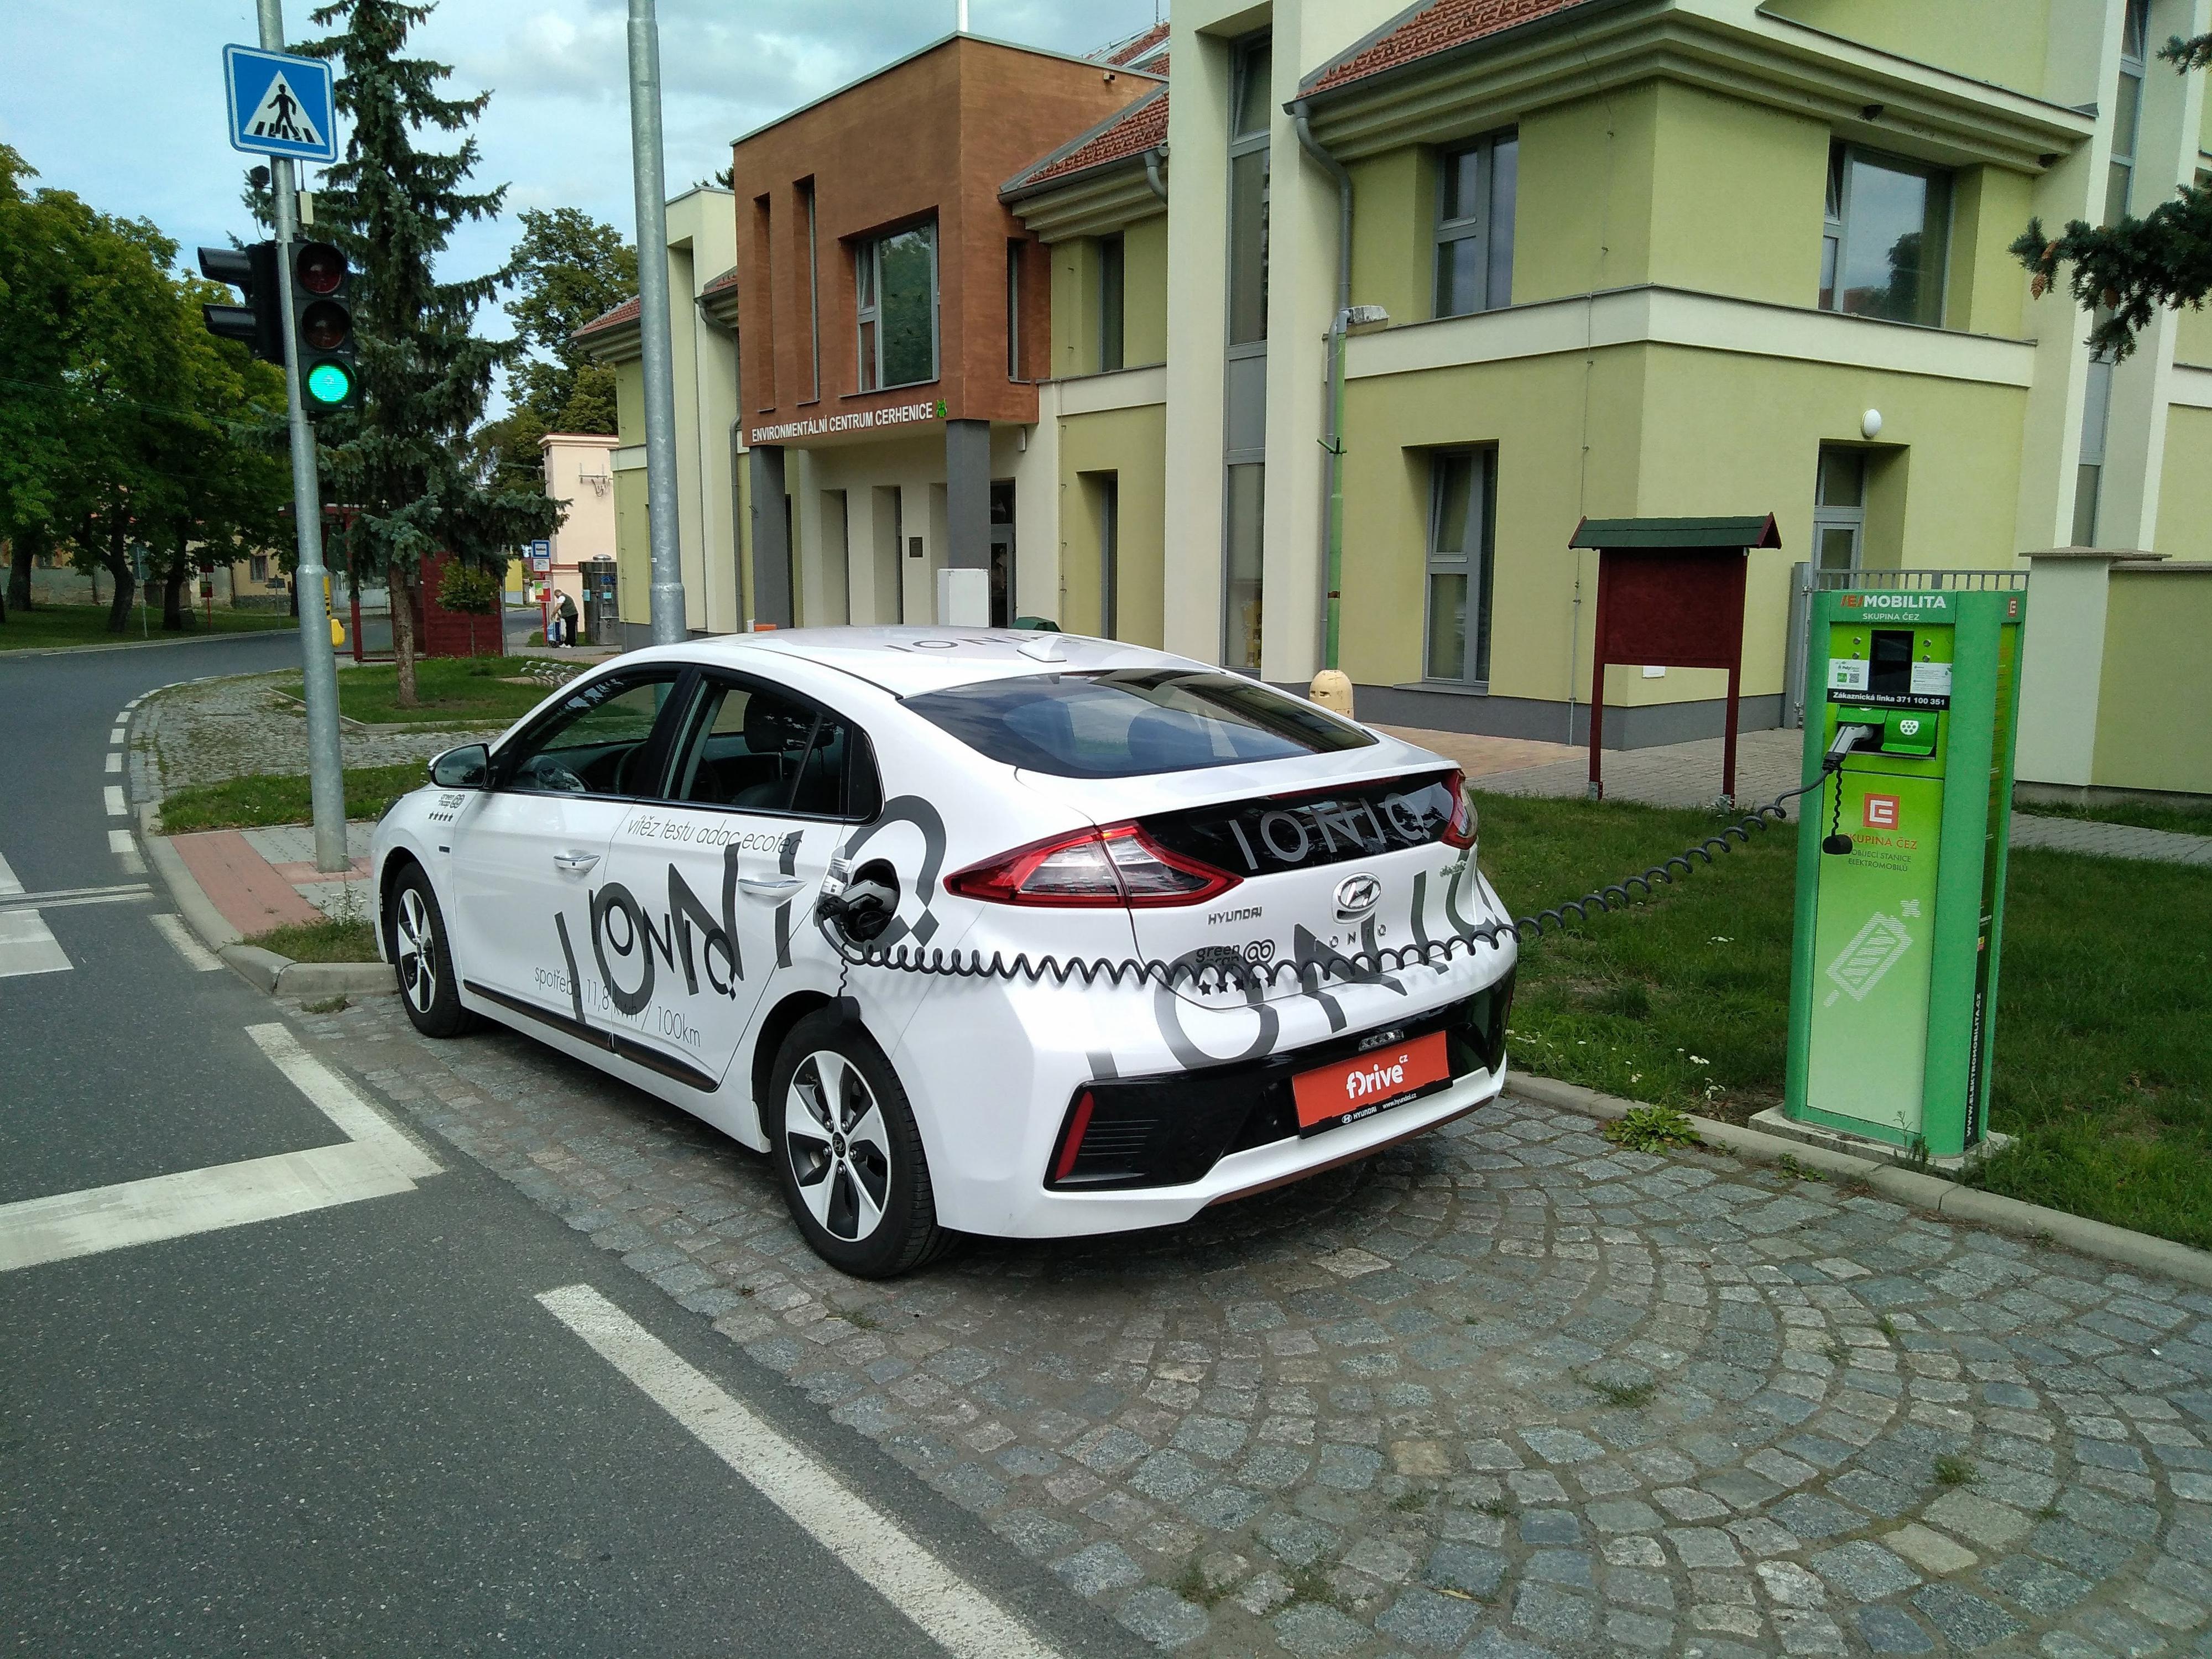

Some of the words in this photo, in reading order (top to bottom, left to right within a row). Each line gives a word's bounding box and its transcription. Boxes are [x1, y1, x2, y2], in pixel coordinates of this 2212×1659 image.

[752, 414, 827, 442] ENVIRONMENTÁLNÍ
[829, 411, 873, 432] CENTRUM
[875, 402, 933, 426] CERHENICE
[1902, 612, 1920, 620] ČEZ
[884, 635, 1080, 653] IONI
[1833, 692, 1875, 701] Zákaznická
[1876, 694, 1895, 702] linka
[627, 815, 661, 837] vítěz
[659, 819, 695, 842] testu
[696, 819, 741, 847] adac
[741, 832, 802, 855] ecotec
[1228, 792, 1430, 870] IONIQ
[1845, 833, 1892, 847] KUPINA
[1896, 836, 1918, 850] ČEZ
[1880, 853, 1912, 863] STANICE
[1207, 906, 1262, 925] HYUNDAI
[1196, 943, 1240, 963] green
[535, 966, 581, 999] spotřeba
[587, 978, 609, 1012] 11,8
[658, 1006, 701, 1048] 100km
[1966, 992, 1981, 1137] WWW.ELEKTROMOBILITA.CZ
[1353, 1105, 1378, 1120] HYUNDAI
